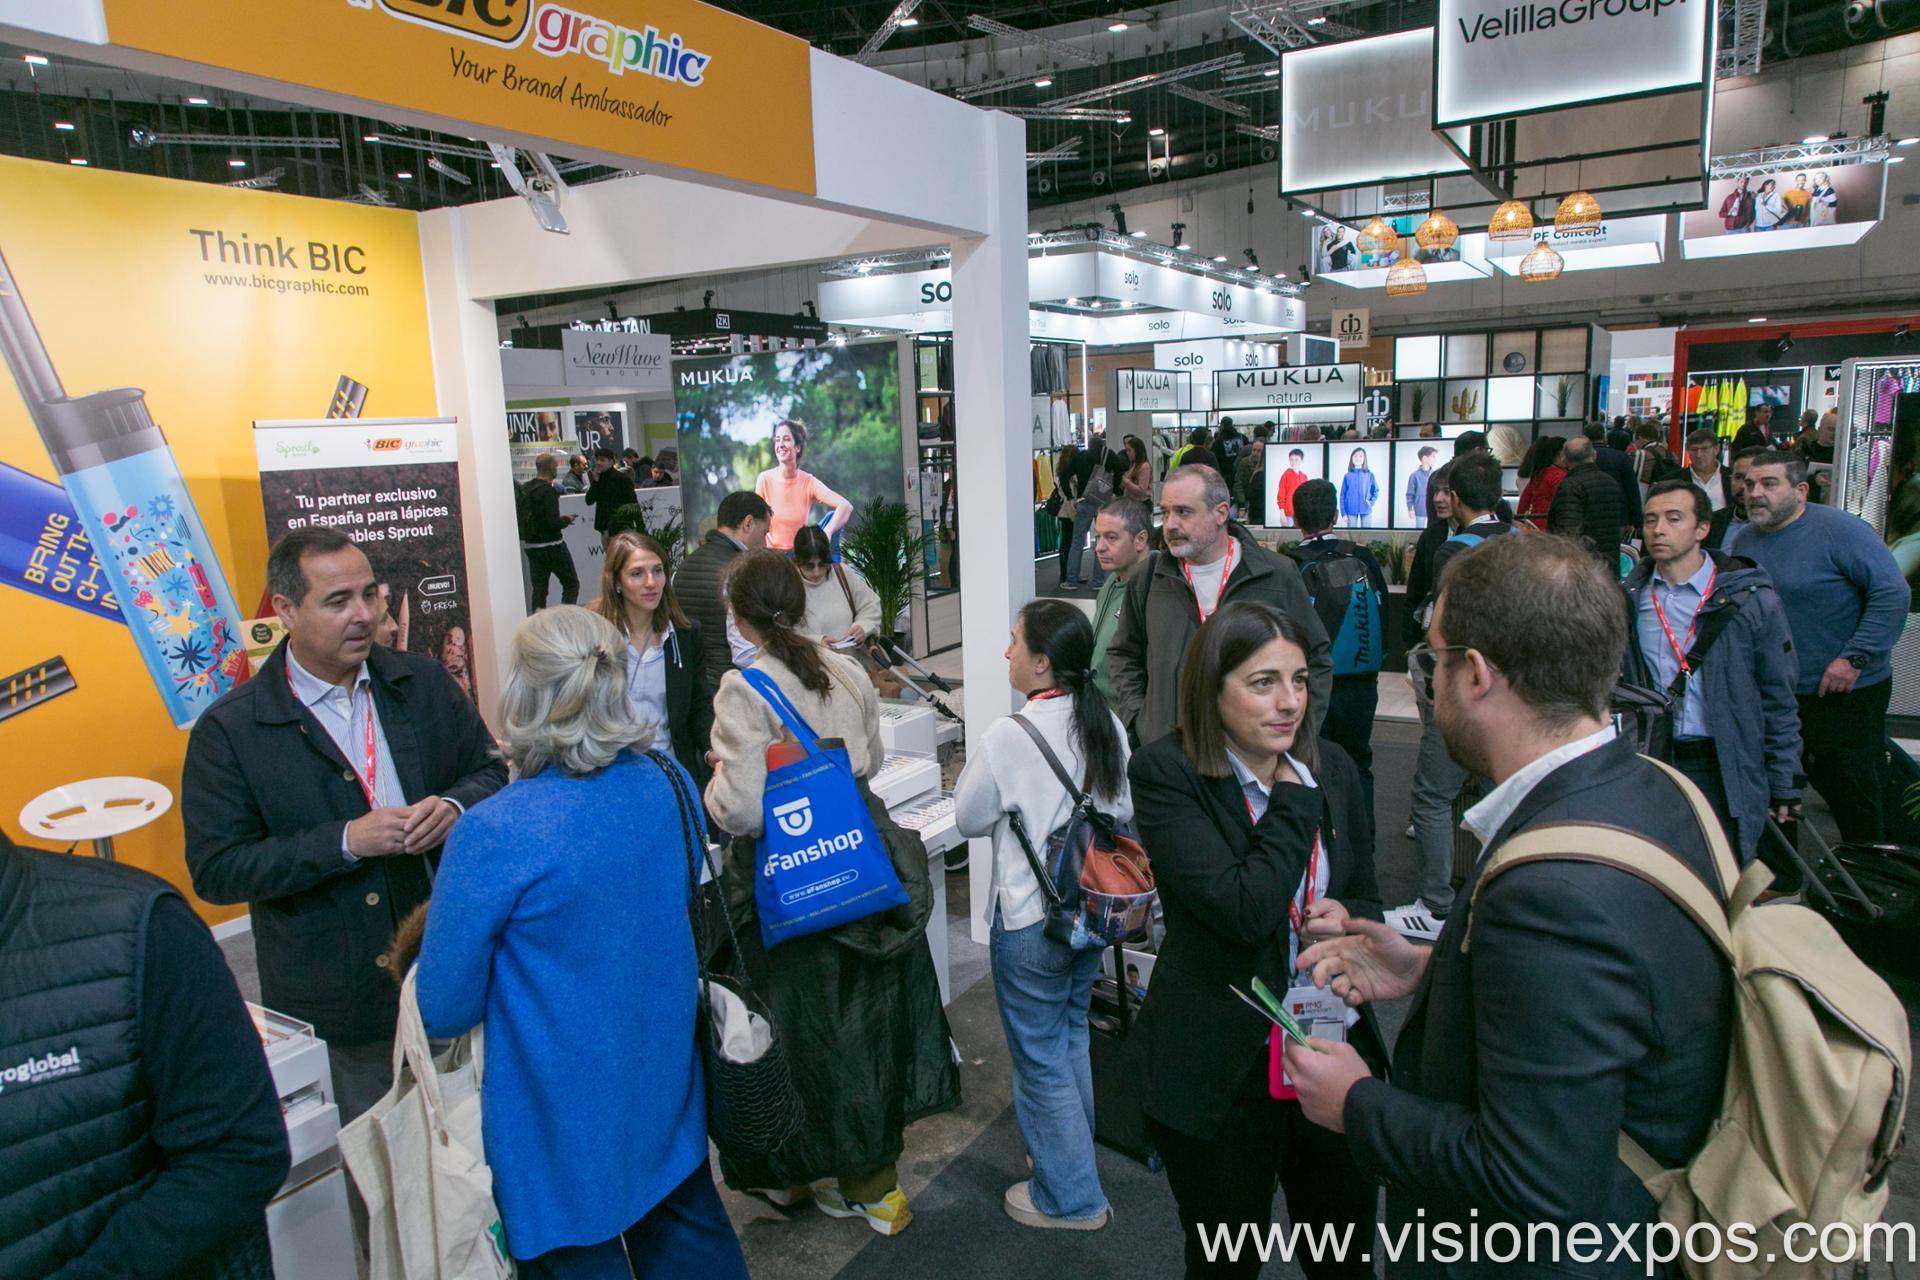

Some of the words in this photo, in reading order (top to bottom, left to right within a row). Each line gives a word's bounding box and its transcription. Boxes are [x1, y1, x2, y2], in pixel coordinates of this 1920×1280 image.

[1458, 0, 1688, 43] VelillaGroup
[537, 8, 707, 83] graphic
[450, 46, 497, 84] Your
[503, 64, 567, 103] Brand
[571, 81, 673, 127] Ambassador
[1533, 230, 1549, 241] PF
[189, 229, 298, 269] Think
[308, 241, 367, 275] BIC
[204, 272, 369, 297] www.bicgraphic.com
[1124, 271, 1139, 286] solo
[1212, 286, 1232, 312] solo
[1148, 320, 1170, 331] solo
[1174, 352, 1204, 367] solo
[1245, 349, 1259, 367] solo
[680, 365, 754, 386] MUKUA
[1125, 373, 1170, 390] MUKUA
[1236, 367, 1345, 388] MUKUA
[1267, 389, 1312, 404] natura
[375, 440, 401, 449] BIC
[296, 494, 314, 509] Tu
[317, 491, 371, 510] partner
[375, 486, 437, 503] exclusivo
[288, 518, 306, 530] en
[310, 512, 363, 529] España
[367, 513, 398, 527] para
[401, 505, 449, 523] lápices
[388, 523, 434, 542] Sprout
[24, 512, 70, 585] BRING
[51, 551, 81, 593] OUT
